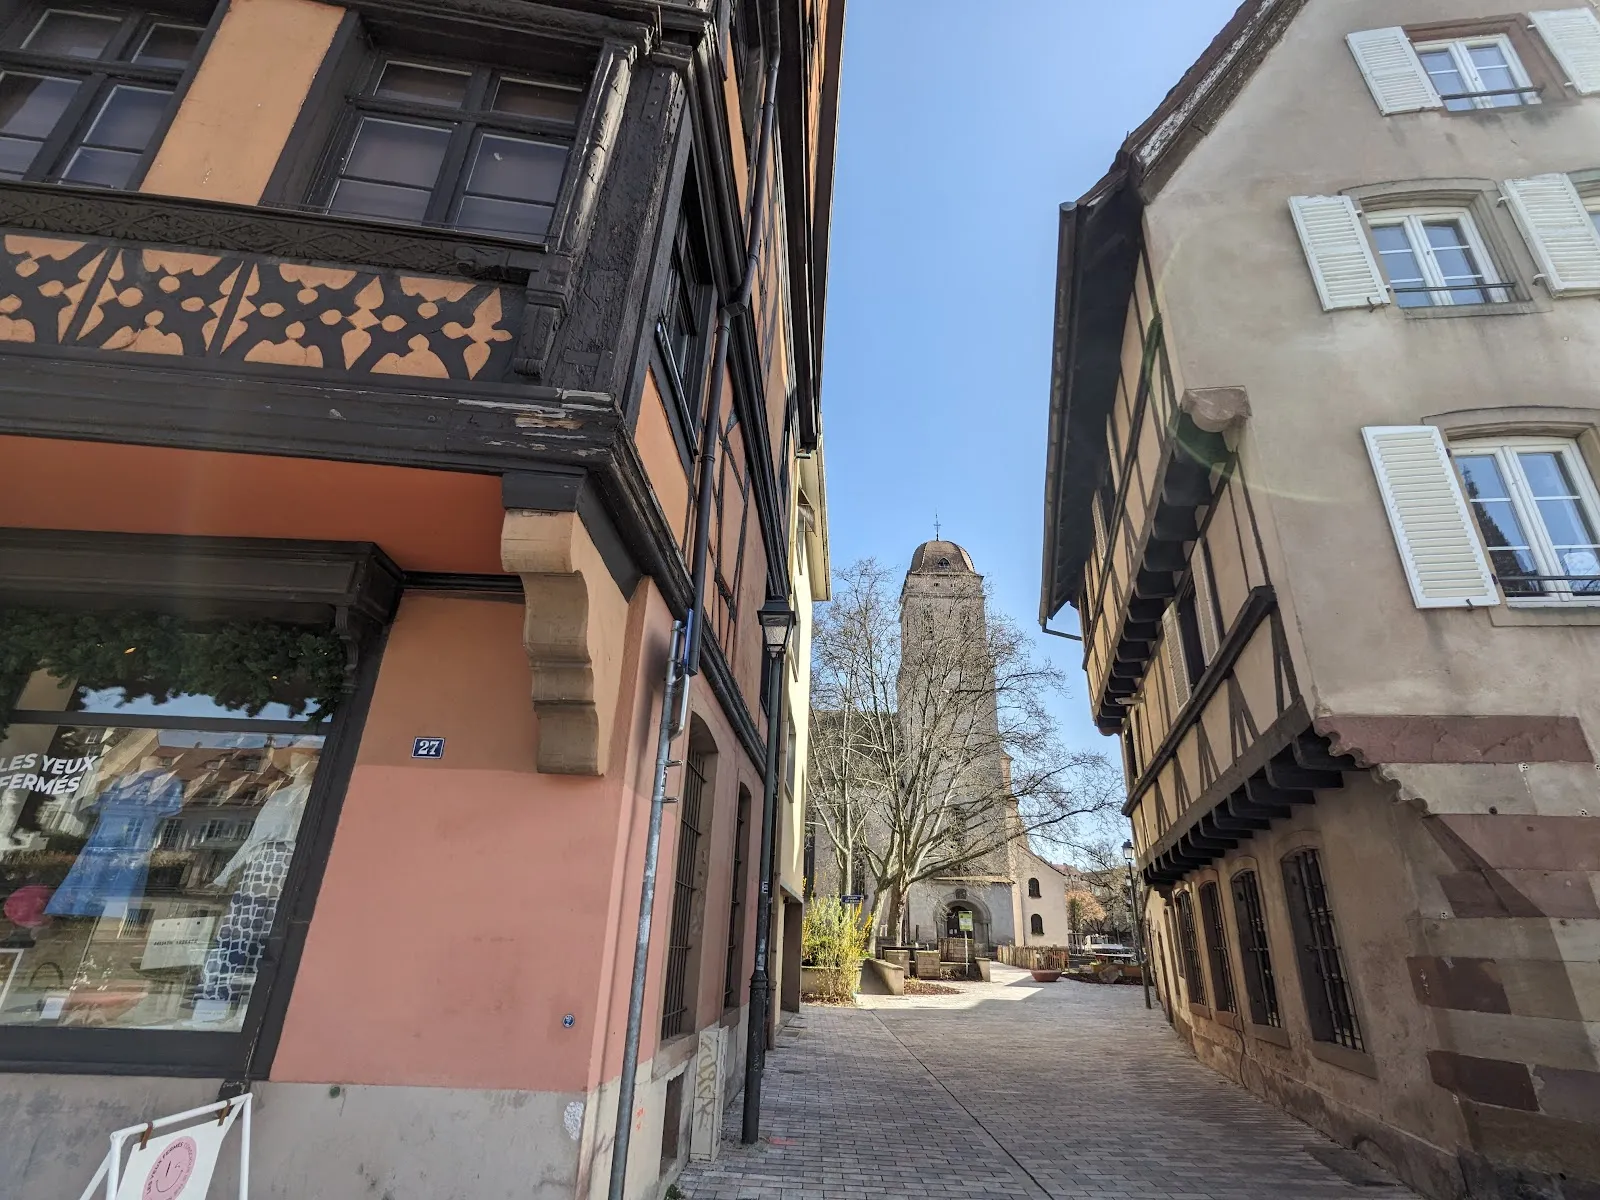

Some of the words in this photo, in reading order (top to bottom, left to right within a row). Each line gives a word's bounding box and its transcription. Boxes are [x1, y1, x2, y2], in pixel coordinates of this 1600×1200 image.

[417, 740, 440, 755] 27
[0, 753, 38, 772] LES
[42, 755, 98, 775] YEUX
[0, 773, 82, 795] FERMÉS
